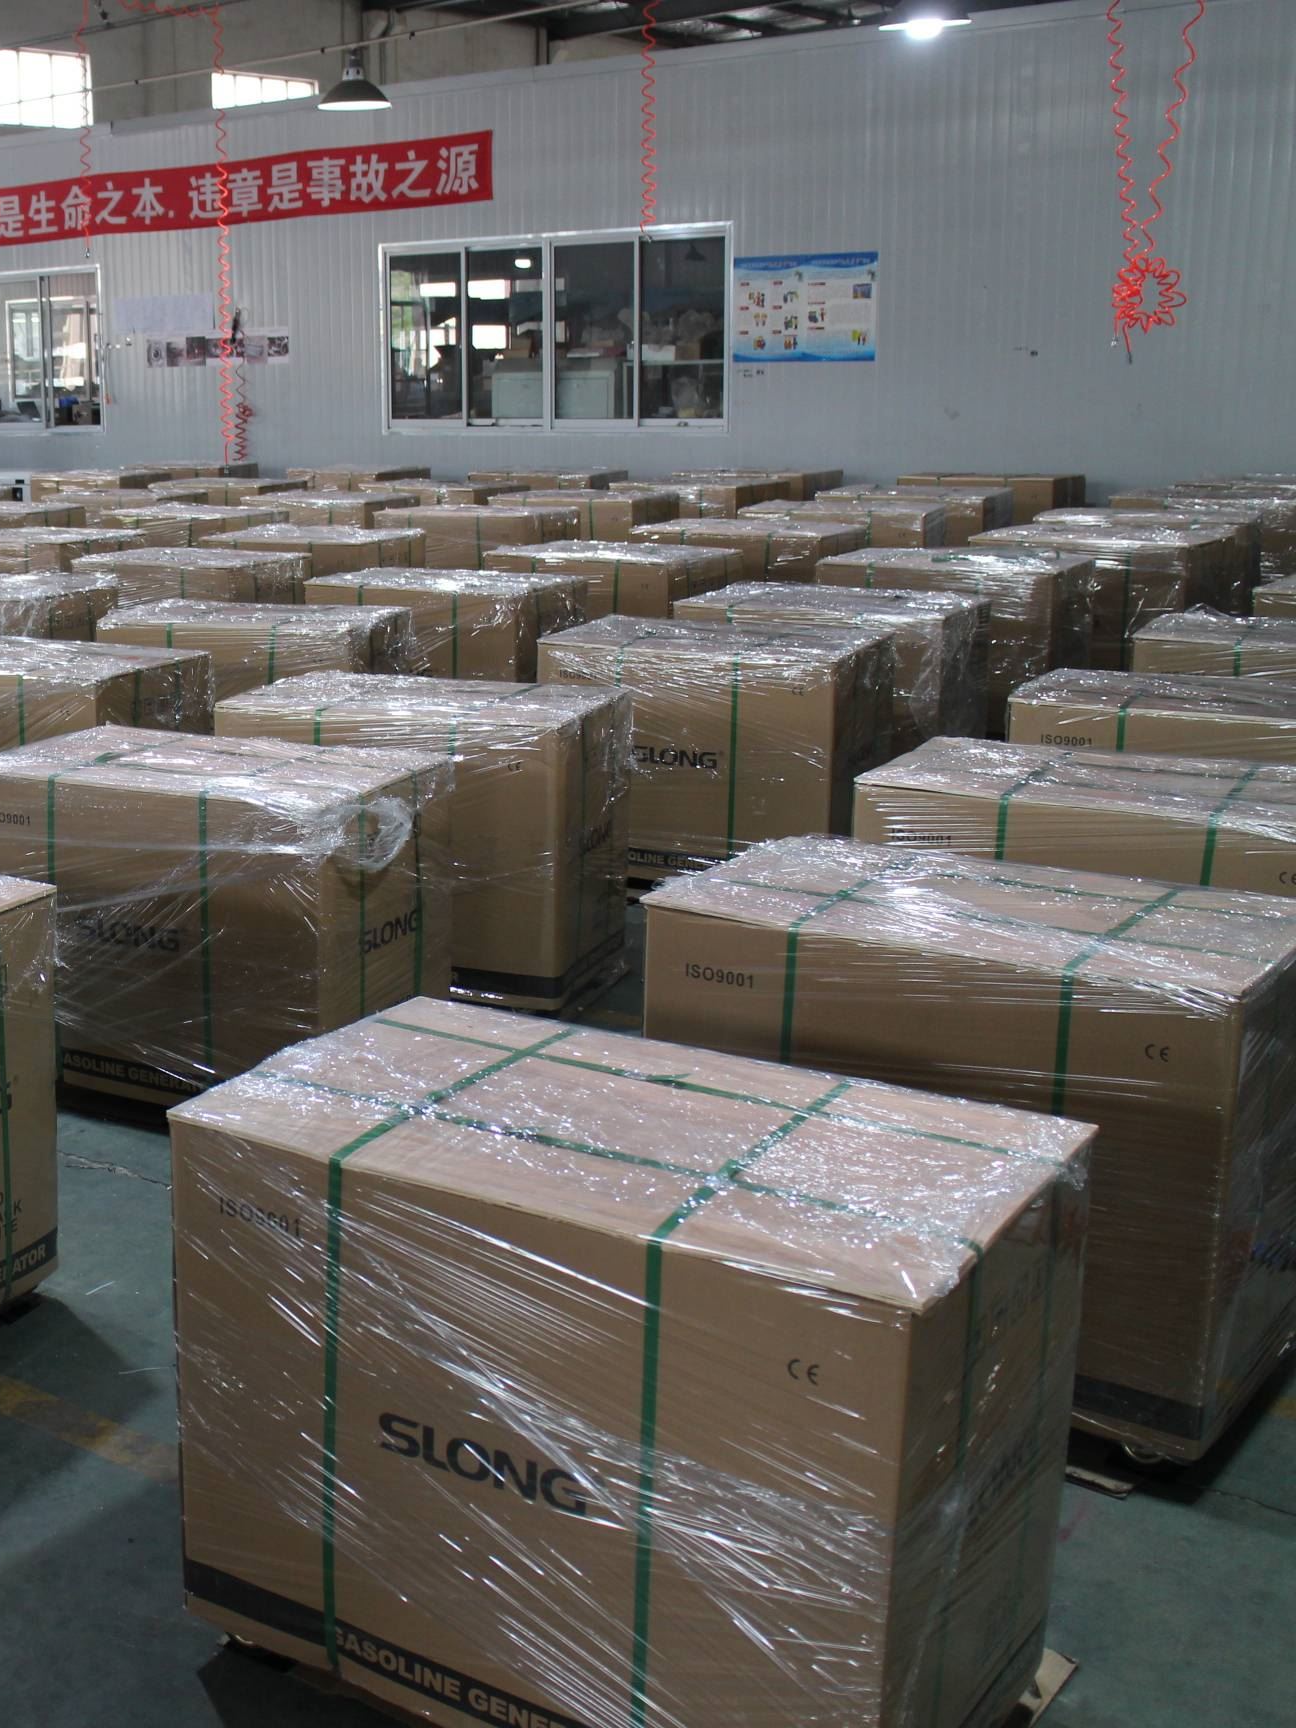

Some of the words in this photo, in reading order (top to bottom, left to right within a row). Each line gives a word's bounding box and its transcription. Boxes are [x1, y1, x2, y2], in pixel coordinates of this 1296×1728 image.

[358, 907, 420, 956] SLONG
[685, 962, 754, 990] ISO9001
[64, 1053, 124, 1077] ASOLINE
[1144, 1043, 1171, 1063] CE
[787, 1358, 820, 1387] CE
[378, 1412, 588, 1517] SLONG
[467, 1687, 560, 1728] GENE
